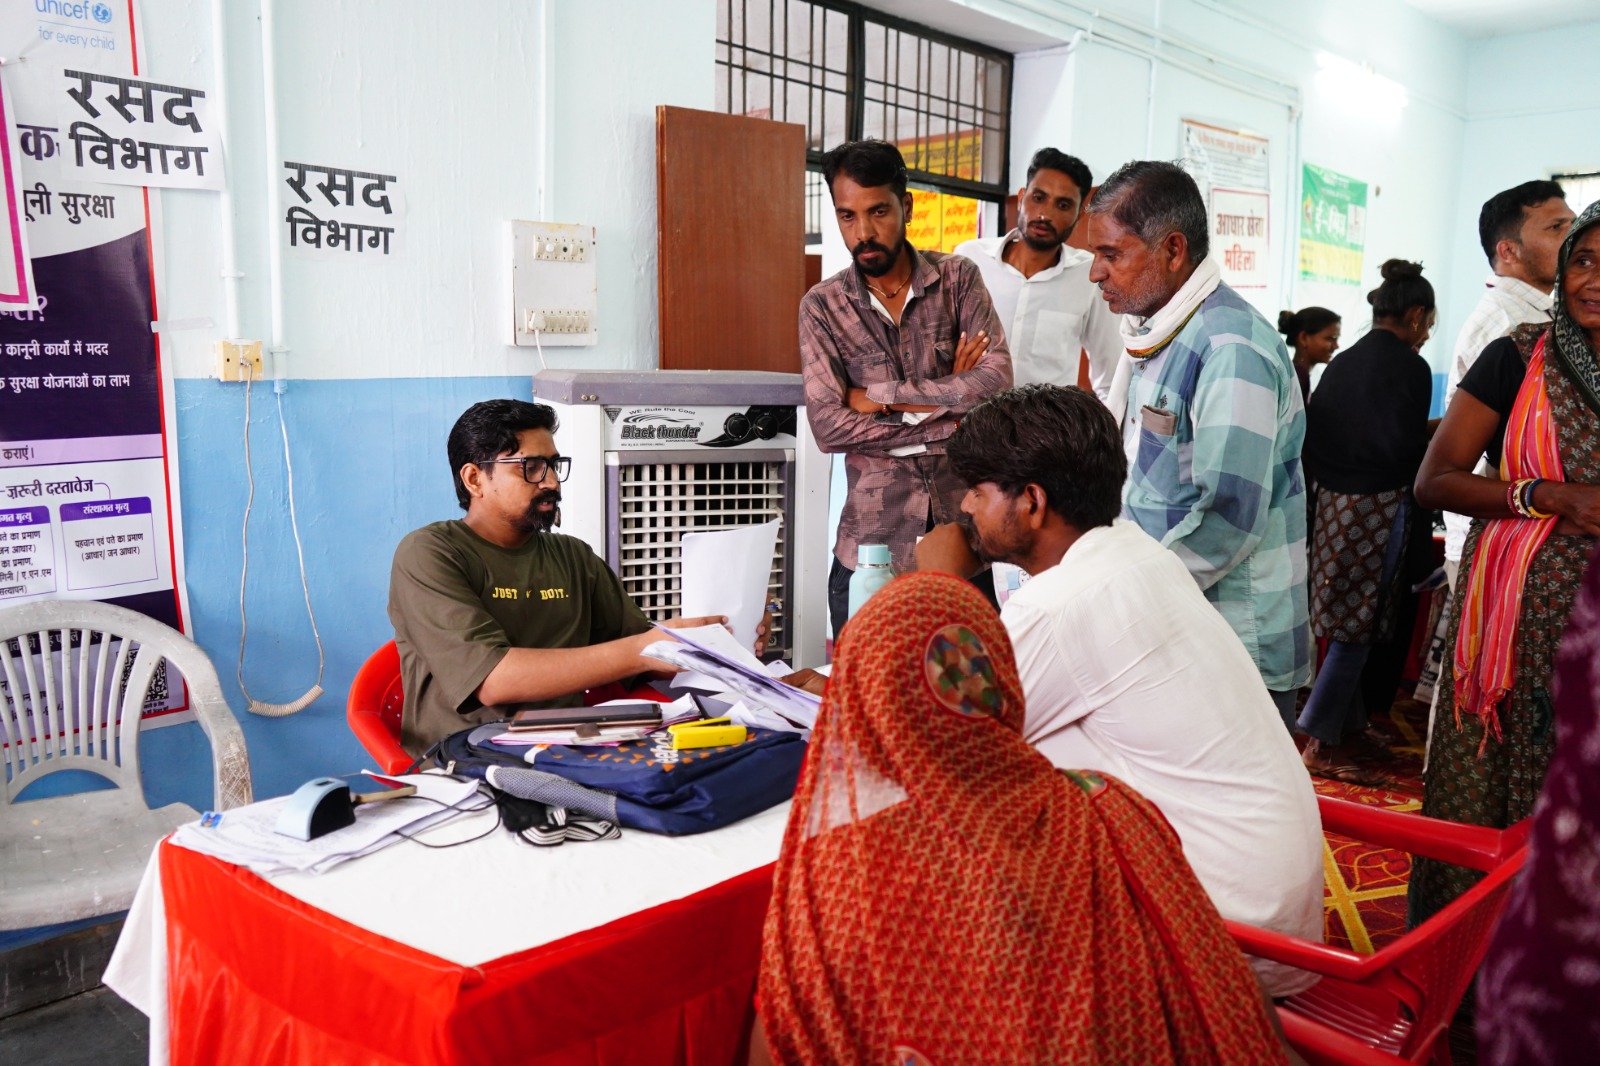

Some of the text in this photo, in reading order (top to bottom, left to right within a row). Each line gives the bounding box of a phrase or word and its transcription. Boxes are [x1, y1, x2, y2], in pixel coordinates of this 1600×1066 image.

[35, 0, 89, 20] unicef
[38, 26, 115, 50] for every child
[64, 69, 206, 133] रसद
[68, 121, 209, 176] विभाग
[284, 161, 396, 214] रसद
[59, 192, 115, 224] सुरक्षा
[286, 206, 395, 254] विभाग
[1217, 212, 1244, 236] आधार
[1224, 243, 1256, 272] महिला
[5, 340, 40, 360] कानूनी
[74, 341, 82, 355] में
[86, 343, 109, 356] मदद
[9, 376, 39, 393] सुरक्षा
[42, 373, 89, 389] योजनाओं
[93, 375, 106, 388] का
[110, 374, 130, 387] लाभ
[621, 424, 701, 439] Black thunder
[45, 476, 93, 495] दस्तावेज
[492, 587, 518, 600] JUST
